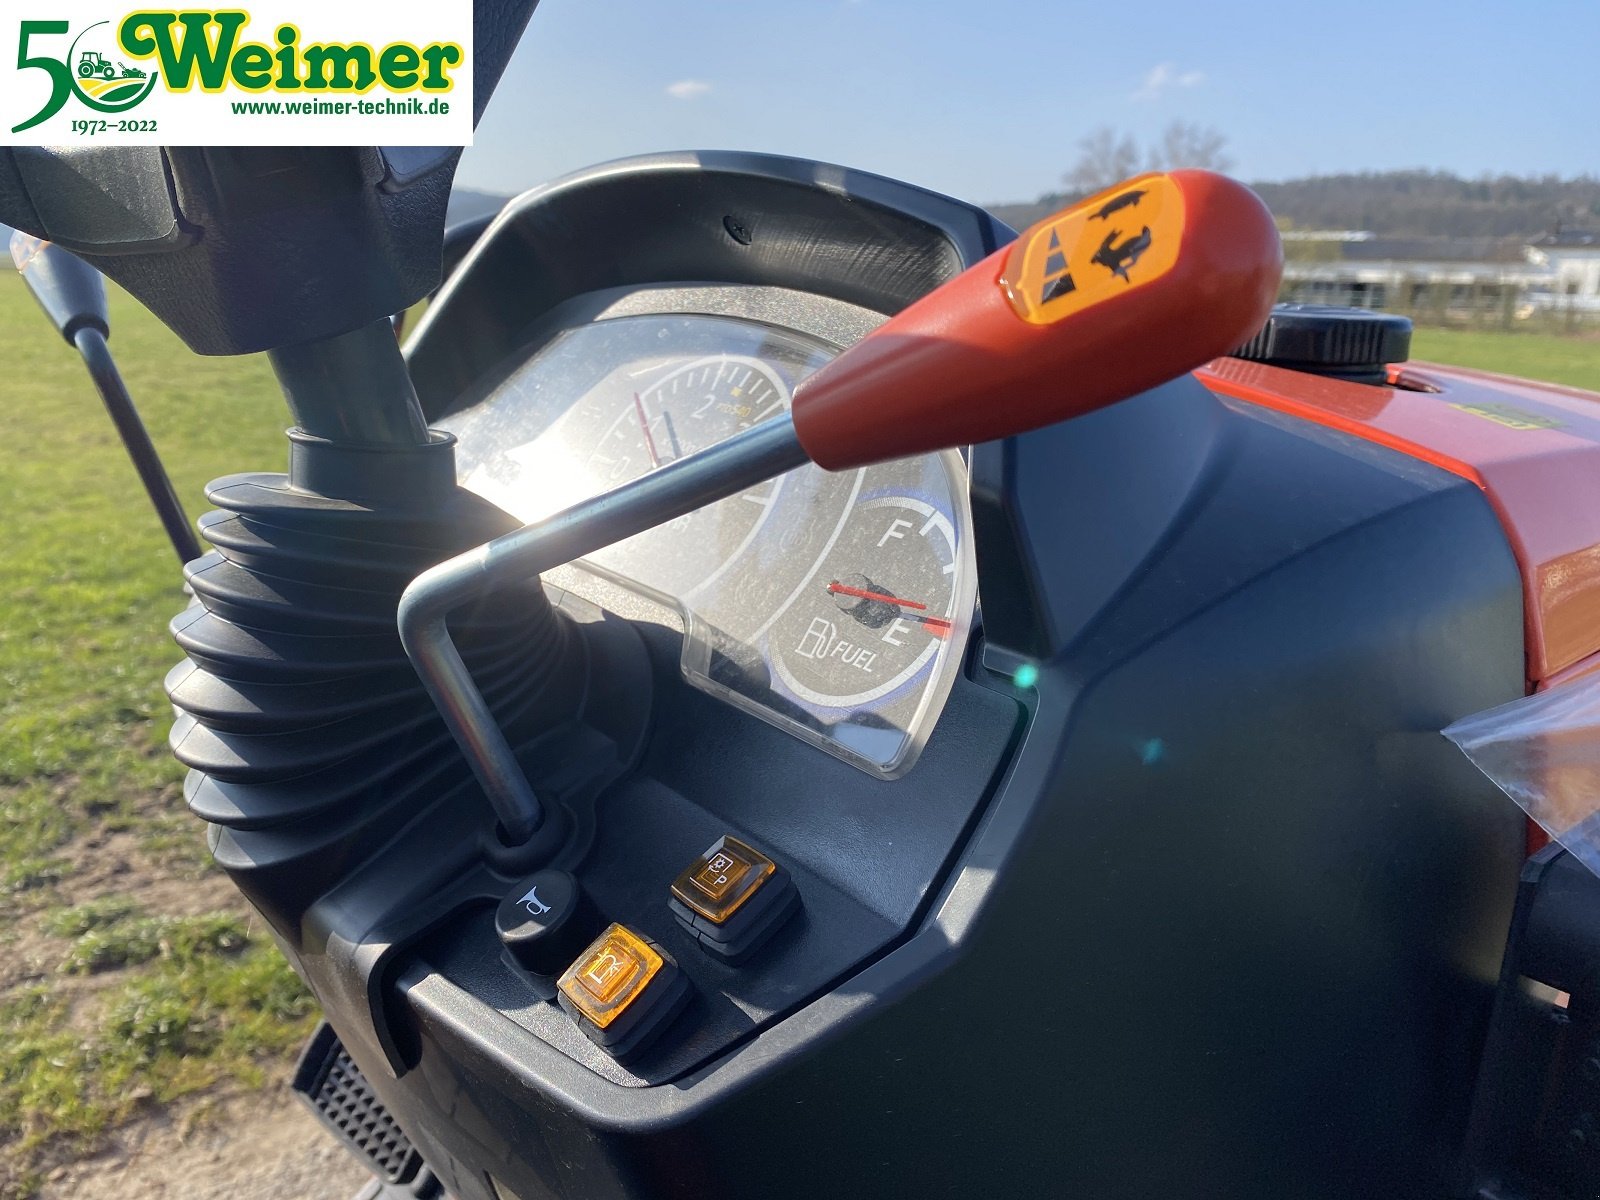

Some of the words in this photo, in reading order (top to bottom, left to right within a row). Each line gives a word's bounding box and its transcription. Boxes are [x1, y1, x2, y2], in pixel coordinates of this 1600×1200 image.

[690, 394, 715, 419] 2
[877, 518, 913, 547] F
[881, 612, 915, 646] E
[831, 640, 877, 672] FUEL
